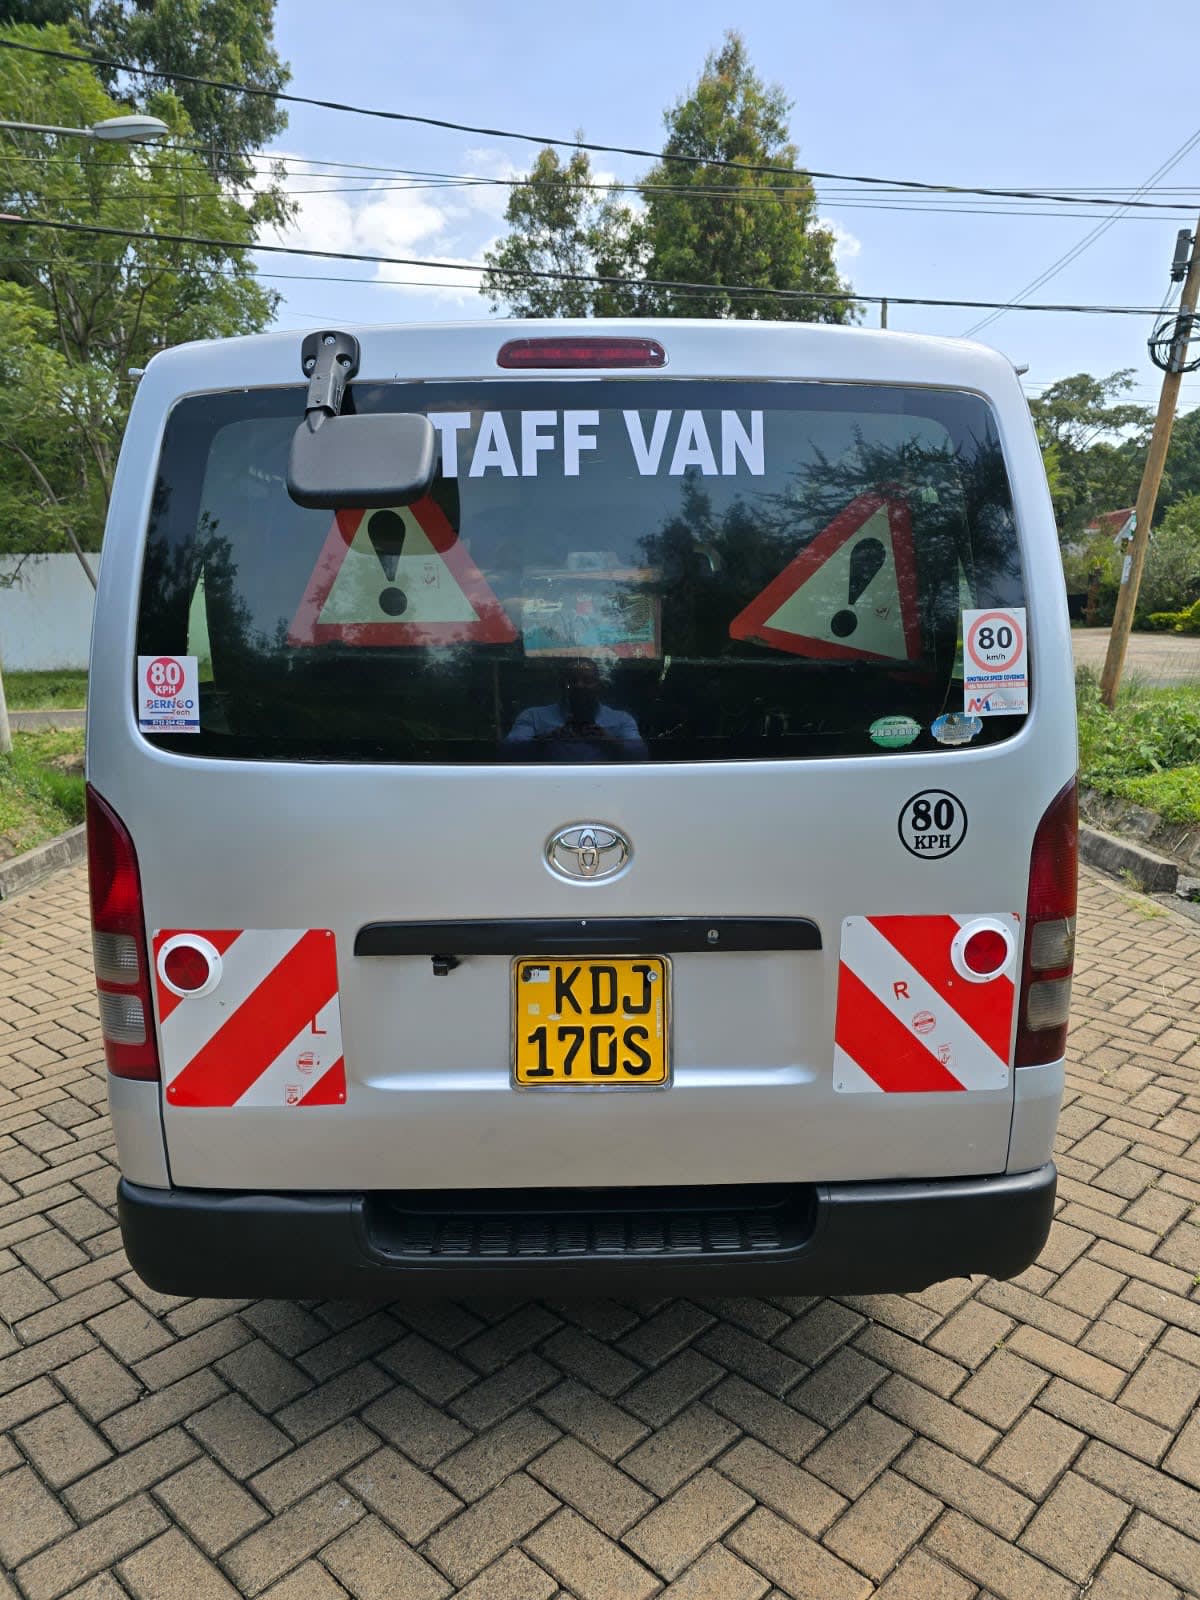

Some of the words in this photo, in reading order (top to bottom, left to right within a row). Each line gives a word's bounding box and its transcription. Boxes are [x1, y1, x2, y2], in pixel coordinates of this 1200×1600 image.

[427, 410, 599, 478] TAFF
[623, 409, 765, 476] VAN
[978, 627, 1013, 649] 80
[151, 662, 181, 685] 80
[155, 685, 176, 694] KPH
[911, 798, 955, 831] 80
[914, 834, 952, 849] KPH
[555, 965, 652, 1014] KDJ
[893, 981, 911, 1000] R
[311, 1013, 327, 1034] L
[526, 1025, 651, 1077] 170S
